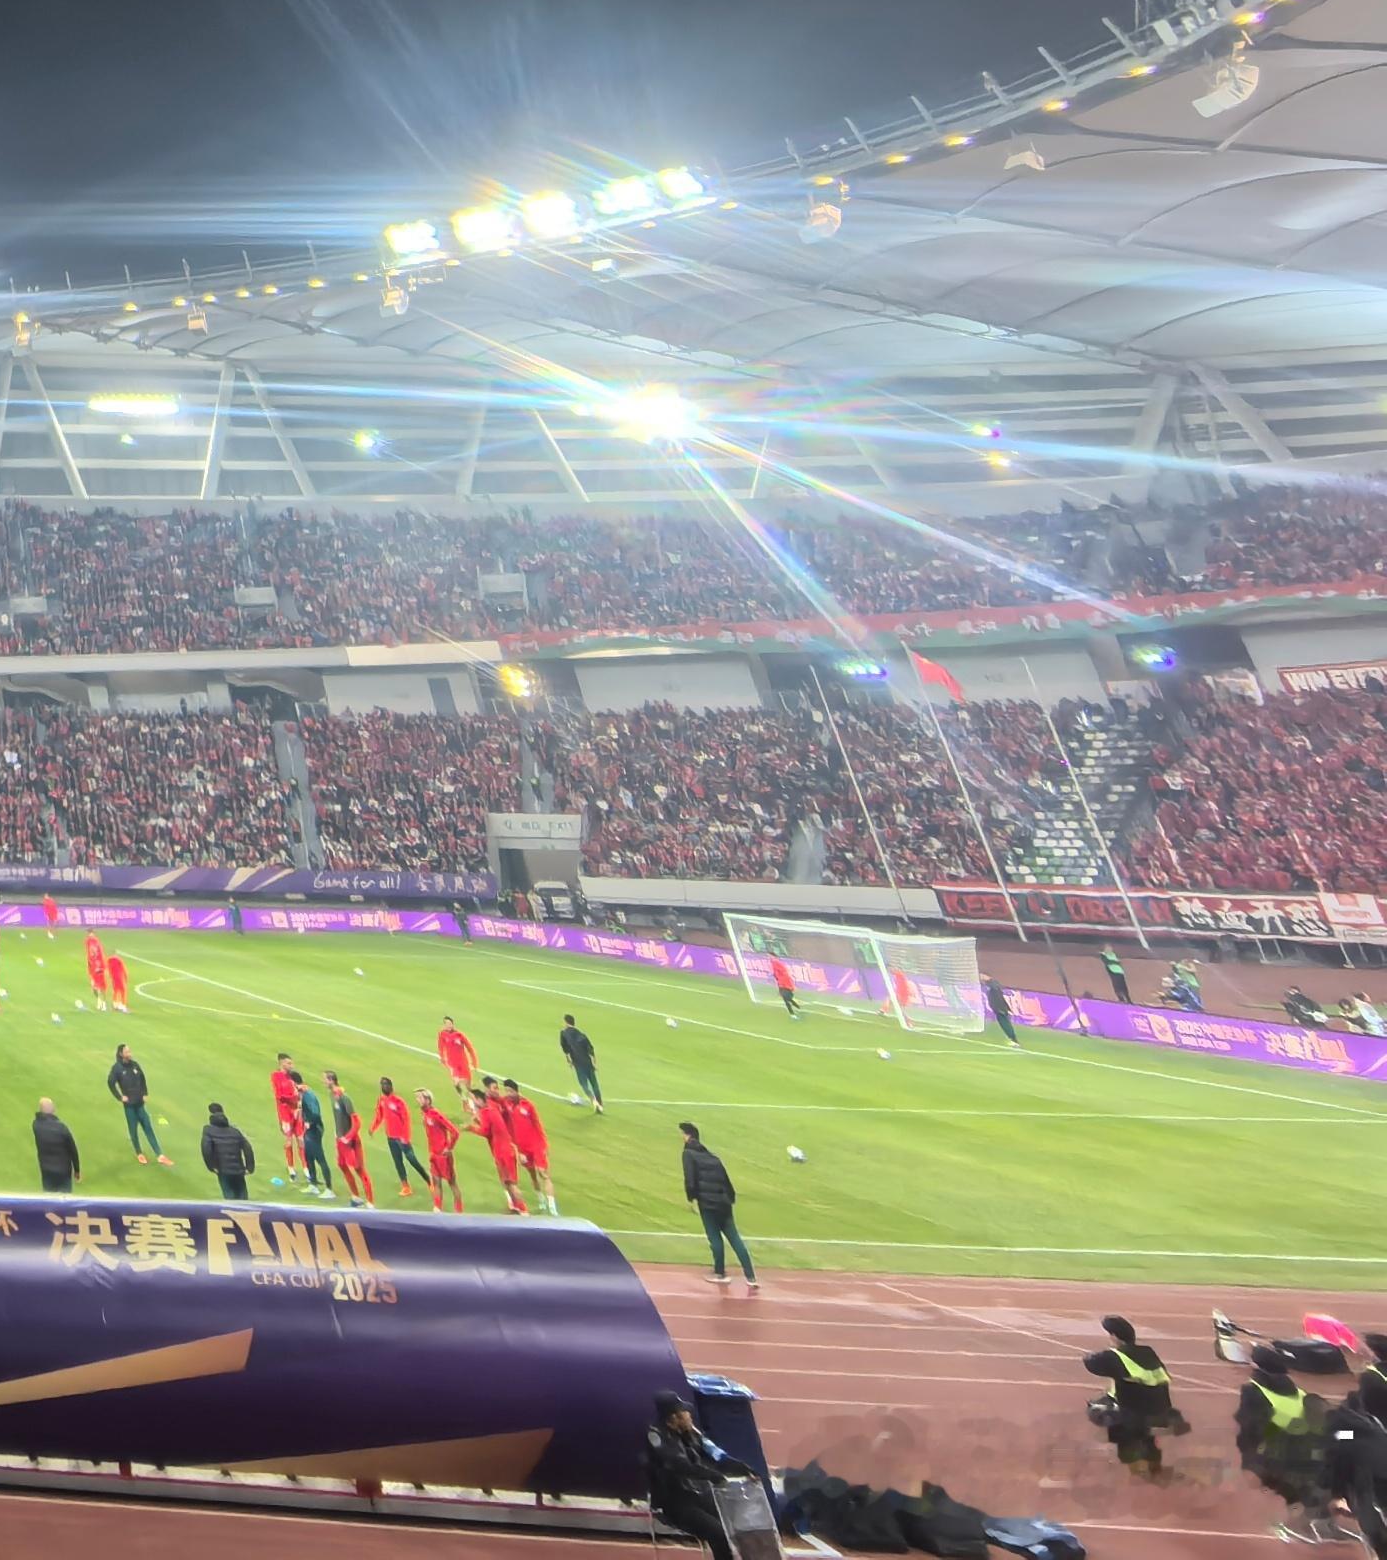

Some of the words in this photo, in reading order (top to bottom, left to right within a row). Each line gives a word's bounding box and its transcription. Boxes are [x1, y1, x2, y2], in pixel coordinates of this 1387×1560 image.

[313, 871, 349, 889] Game
[352, 874, 376, 889] for
[45, 1210, 198, 1276] 决赛
[207, 1209, 399, 1276] FINAL
[251, 1271, 286, 1287] CFA
[290, 1273, 324, 1289] CUP
[329, 1272, 399, 1304] 2025
